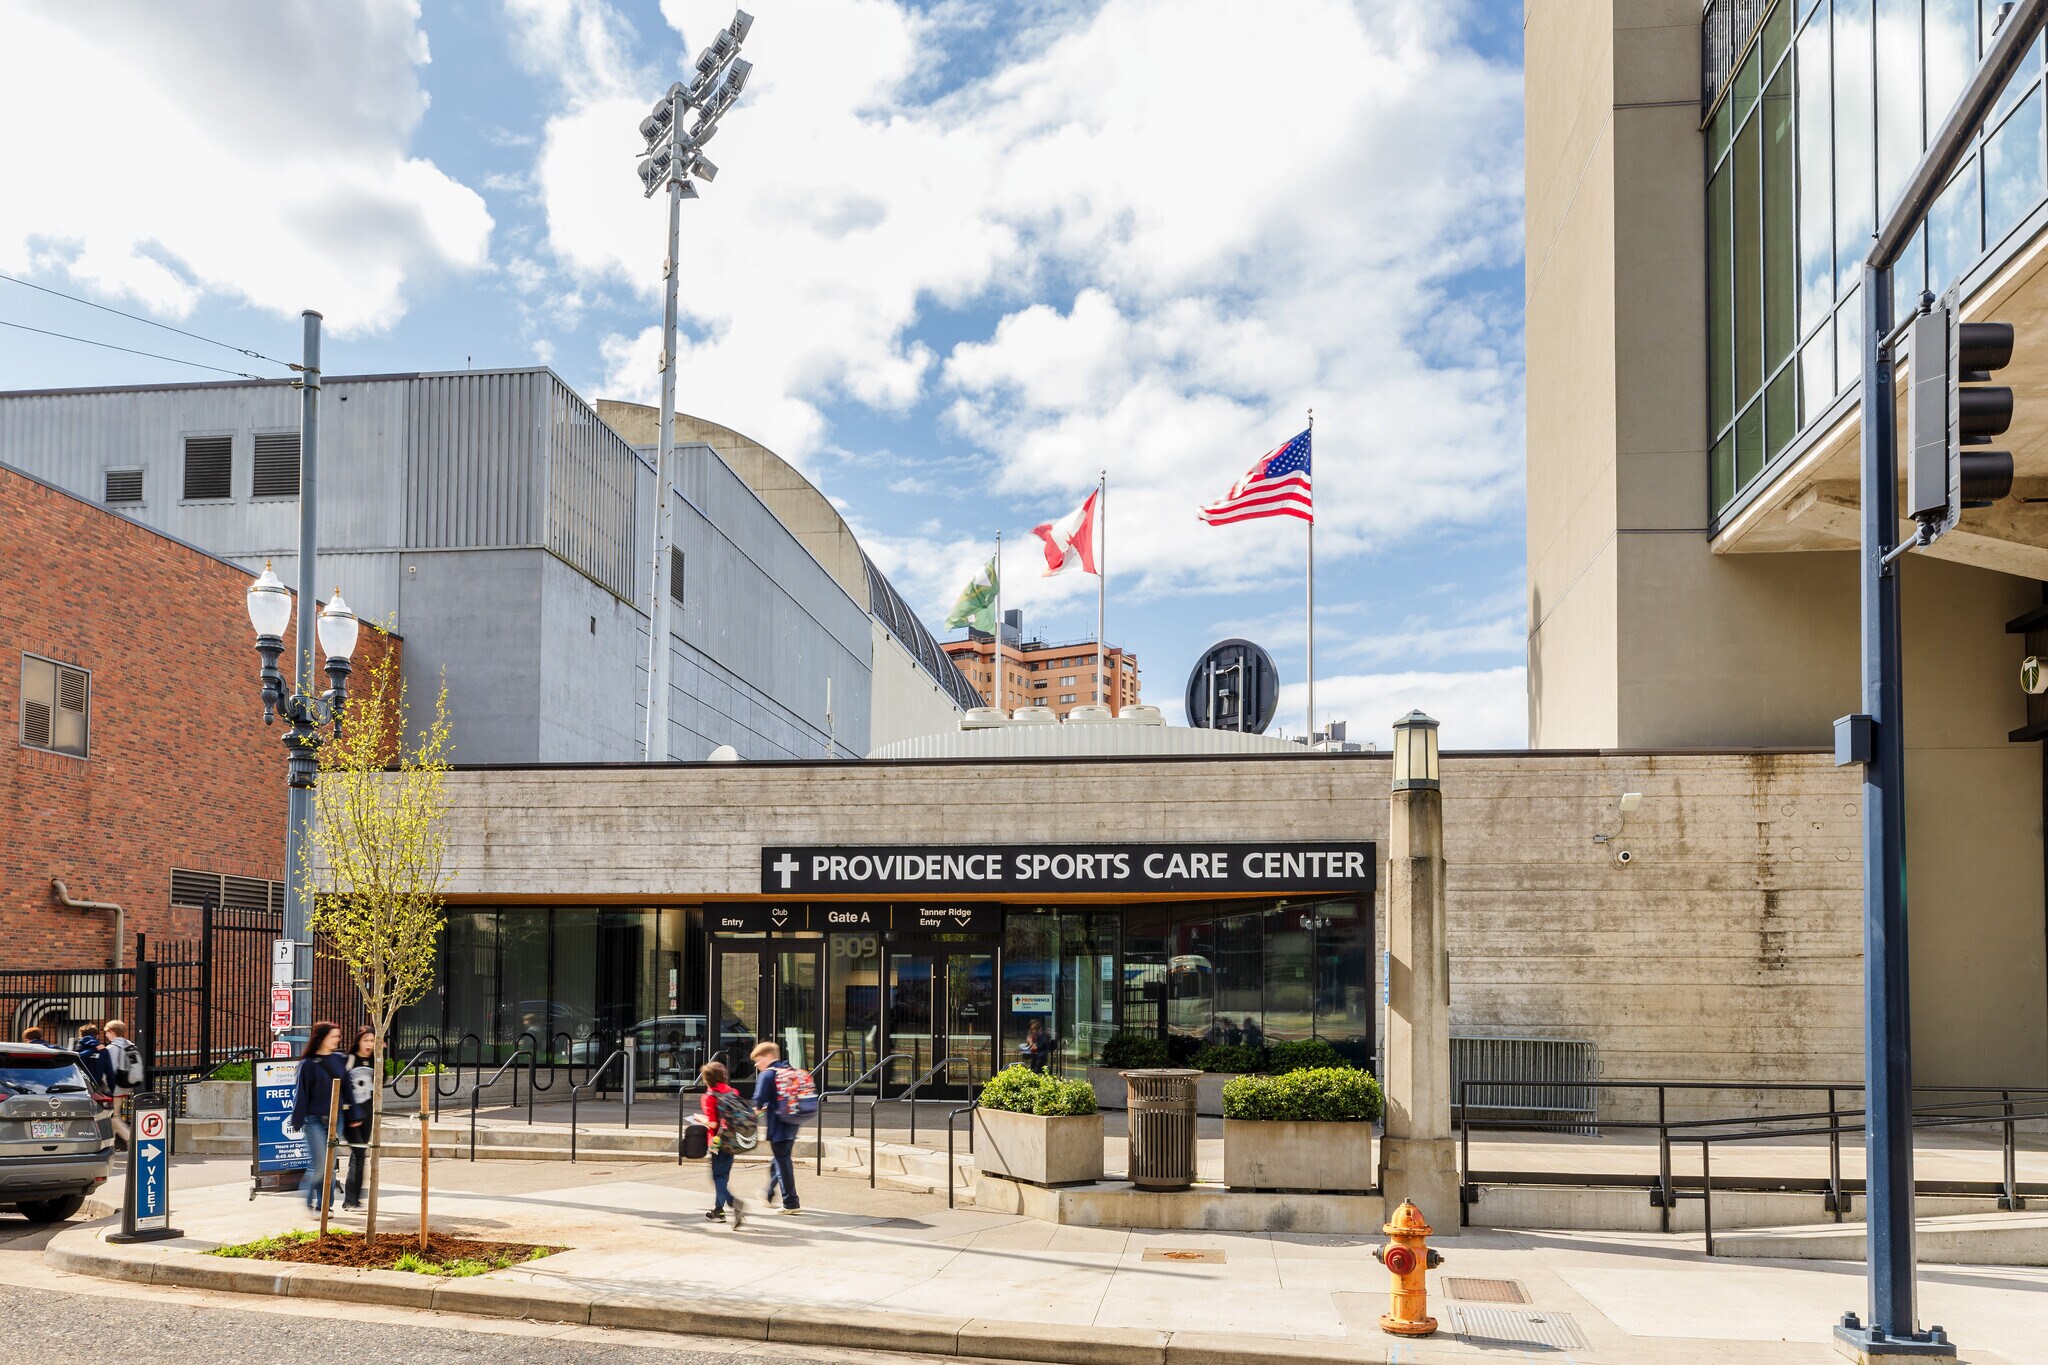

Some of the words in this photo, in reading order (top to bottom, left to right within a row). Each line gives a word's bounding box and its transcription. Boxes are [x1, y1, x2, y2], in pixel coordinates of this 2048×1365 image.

[812, 854, 1002, 881] PROVIDENCE
[1015, 853, 1130, 880] SPORTS
[1143, 852, 1228, 879] CARE
[1242, 852, 1366, 879] CENTER
[771, 908, 788, 916] Club
[828, 911, 858, 923] Gate
[860, 911, 871, 923] A
[920, 908, 946, 916] Tanner
[948, 908, 972, 917] Ridge
[721, 918, 744, 928] Entry
[920, 919, 941, 928] Entry
[833, 937, 877, 958] 909
[266, 1089, 290, 1099] FREE
[34, 1124, 47, 1134] 530
[50, 1124, 64, 1133] PAN
[147, 1165, 156, 1214] VALET
